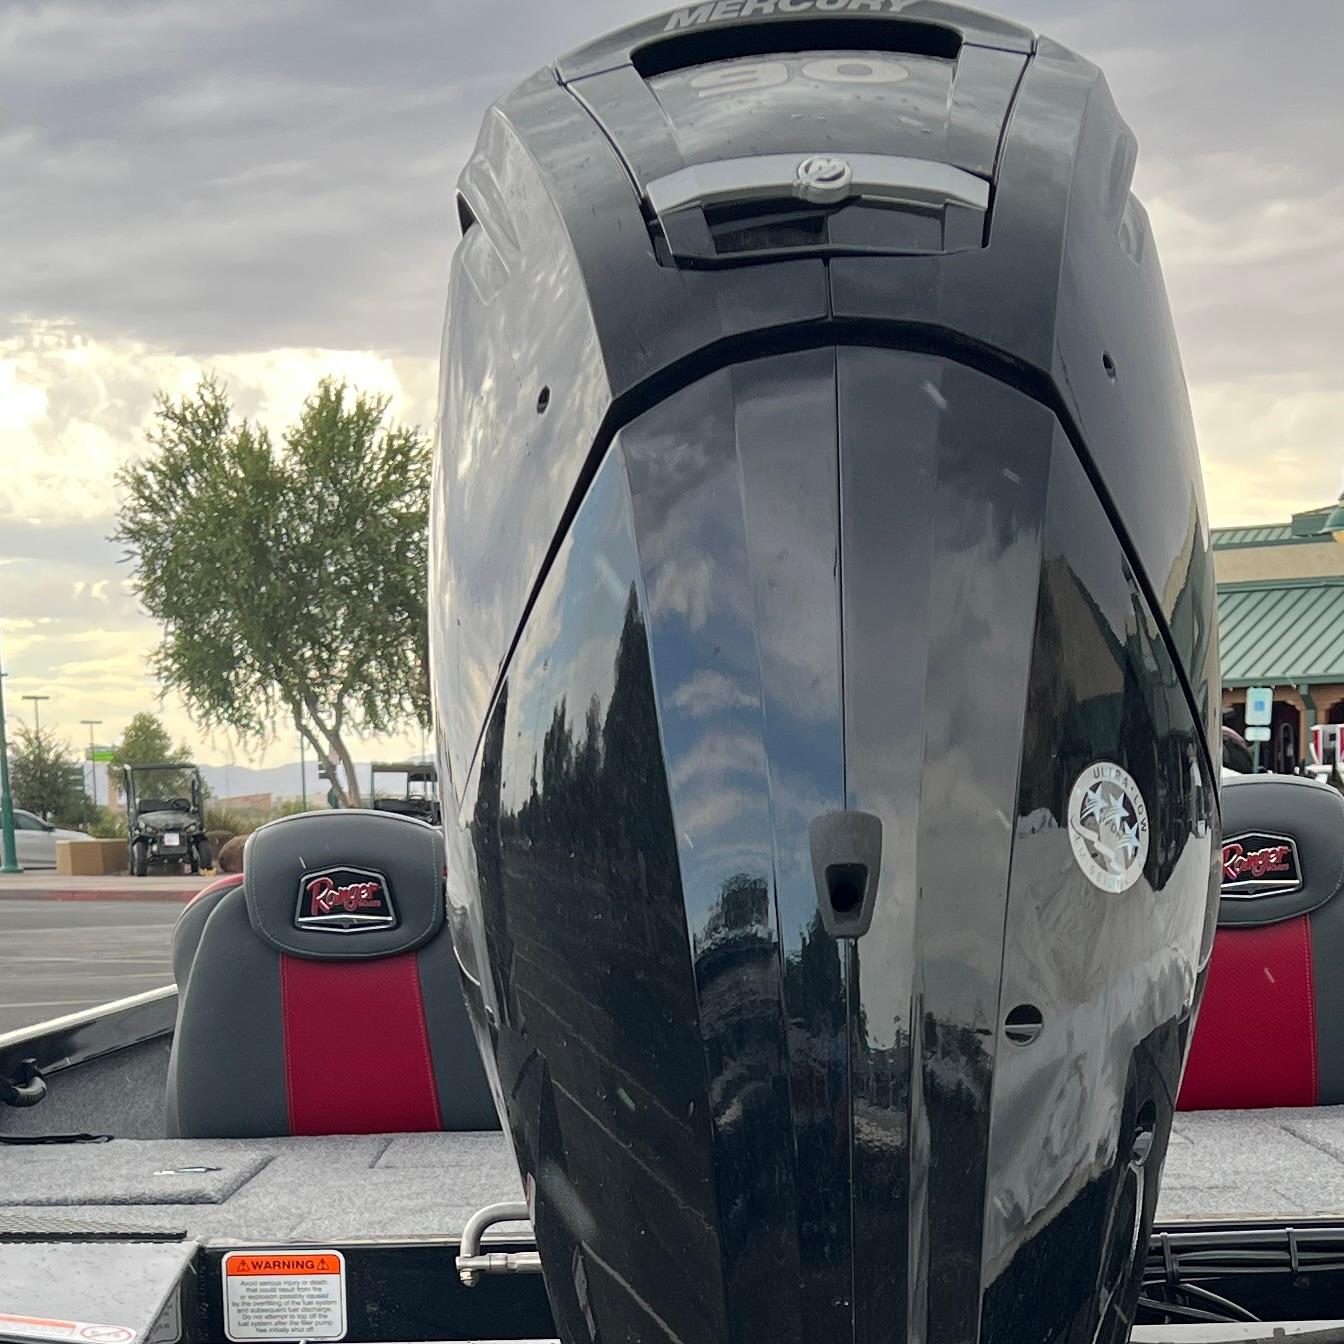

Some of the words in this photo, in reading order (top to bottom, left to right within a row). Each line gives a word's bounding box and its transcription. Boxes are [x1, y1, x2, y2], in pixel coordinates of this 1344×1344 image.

[664, 0, 907, 31] MERCURY
[1092, 767, 1129, 787] ULTRA
[1134, 793, 1148, 832] LOW
[307, 877, 382, 915] Ranger
[251, 1260, 314, 1270] WARNING
